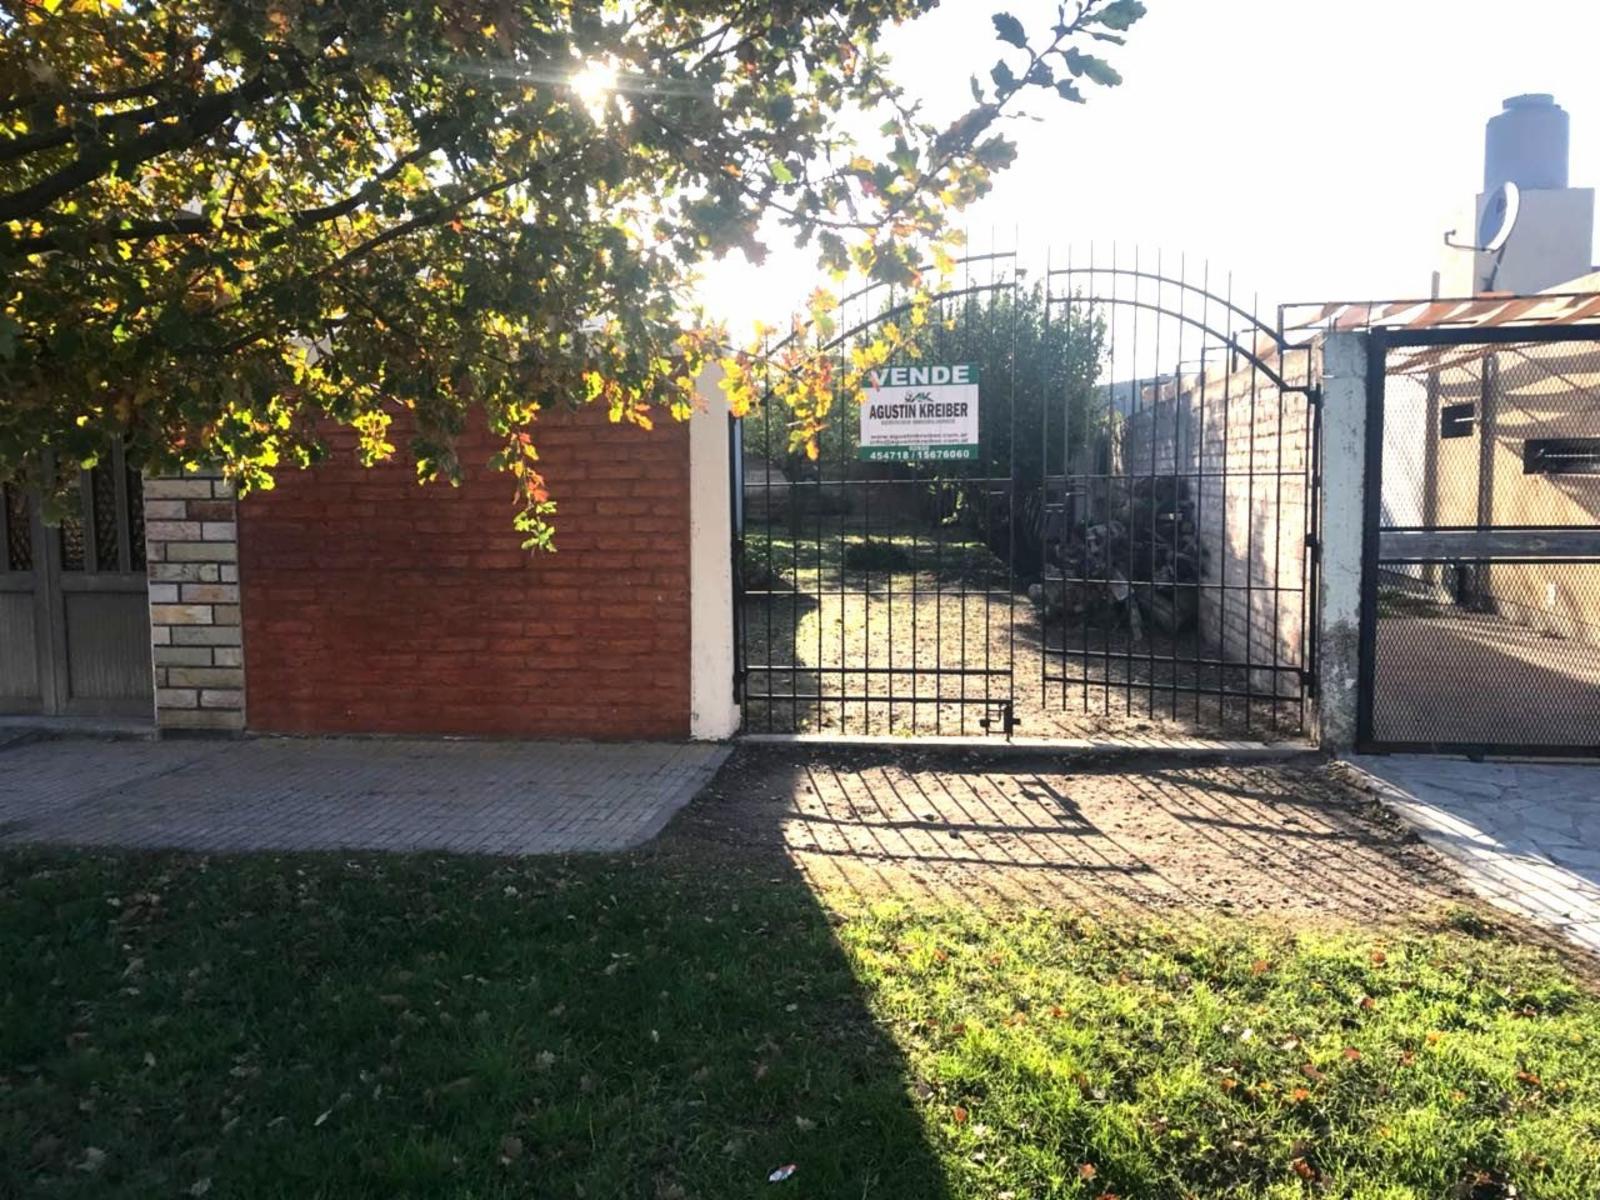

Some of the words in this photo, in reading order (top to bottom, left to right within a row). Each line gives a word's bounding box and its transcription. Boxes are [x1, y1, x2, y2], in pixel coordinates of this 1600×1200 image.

[870, 365, 969, 386] VENDE
[869, 404, 916, 420] AGUSTIN
[919, 402, 968, 419] KREIBER
